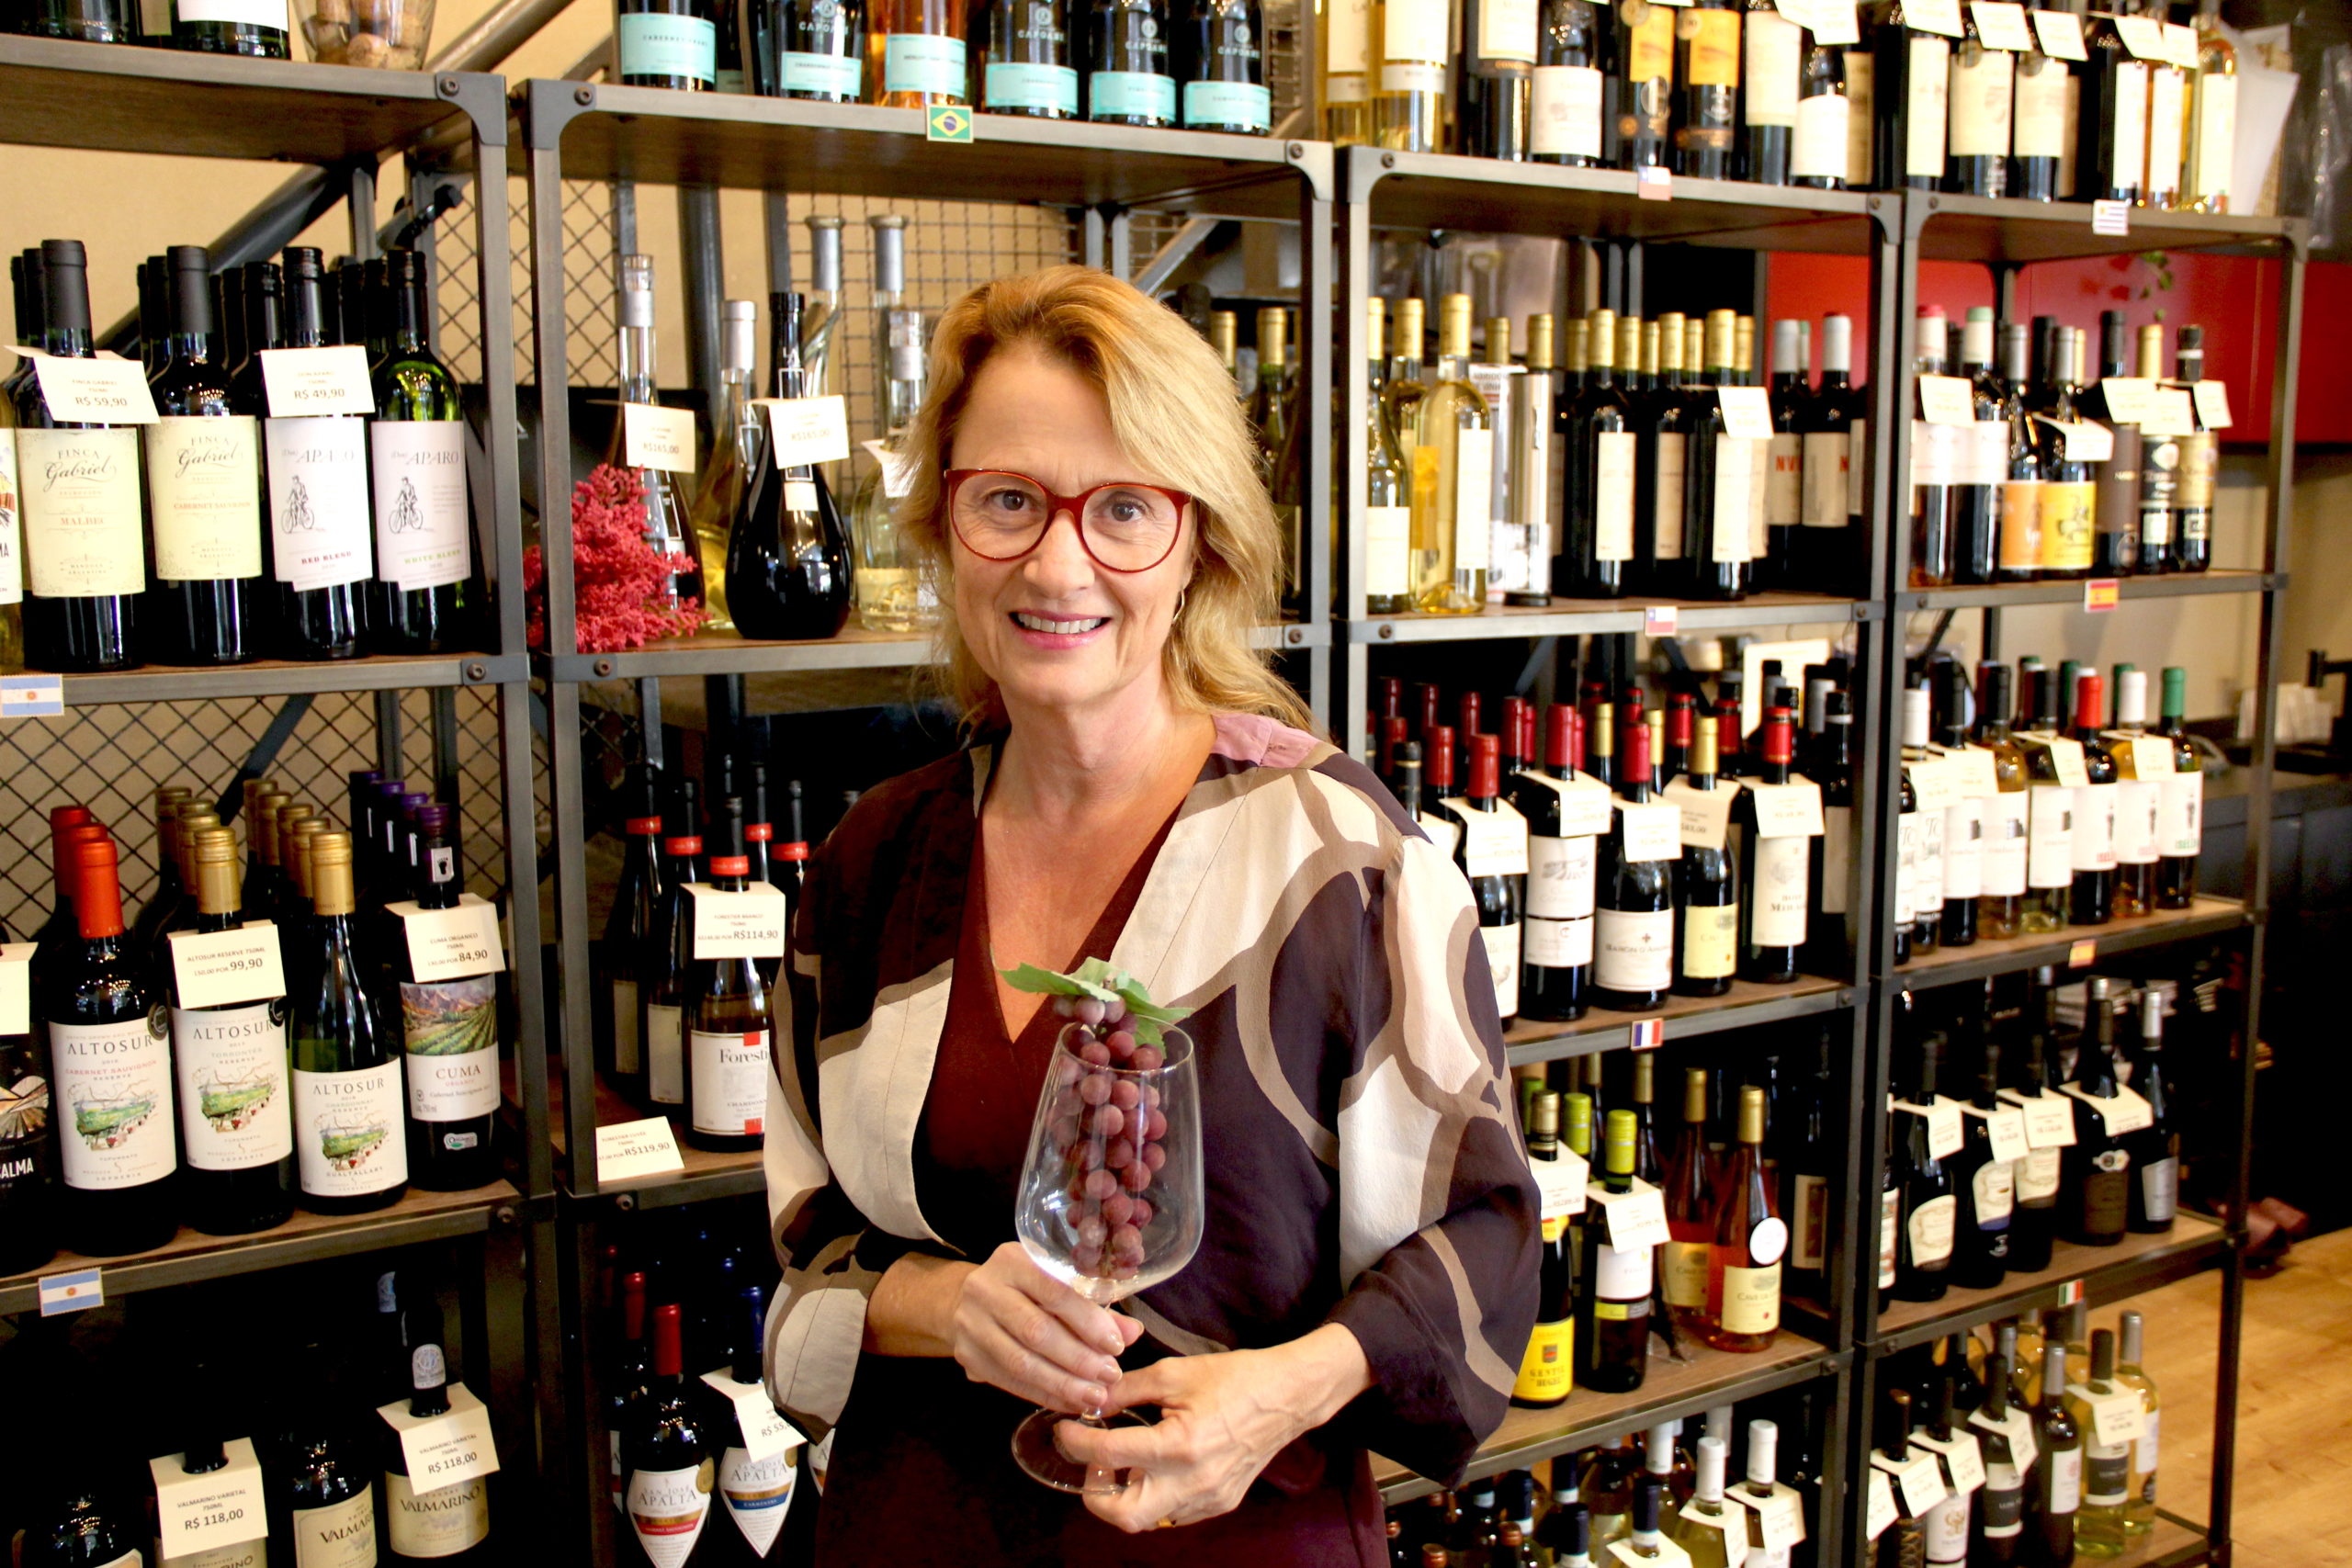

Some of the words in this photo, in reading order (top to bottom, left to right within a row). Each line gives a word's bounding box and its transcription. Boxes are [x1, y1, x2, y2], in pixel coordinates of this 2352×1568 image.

[294, 389, 309, 400] R$
[312, 388, 345, 400] 49,90
[75, 396, 91, 407] R$
[95, 397, 128, 408] 59,90
[191, 436, 229, 446] FINCA
[58, 448, 99, 459] FINCA
[175, 442, 243, 479] Gabriel
[405, 451, 459, 465] APARO
[43, 456, 117, 492] Gabriel
[61, 516, 104, 525] MALBEC
[301, 557, 320, 565] RED
[322, 551, 352, 561] BLEND
[733, 930, 779, 941] R$114,90
[187, 953, 216, 963] ALTOSUR
[218, 949, 243, 958] RESERVE
[459, 949, 488, 963] 84,90
[230, 957, 264, 971] 99,90
[193, 1019, 274, 1041] ALTOSUR
[67, 1034, 154, 1055] ALTOSUR
[65, 1066, 107, 1076] CABERNET
[110, 1059, 157, 1075] SAUVIGNON
[435, 1064, 481, 1079] CUMA
[312, 1077, 385, 1095] ALTOSUR
[625, 1142, 671, 1156] R$119,90
[761, 1427, 773, 1438] R$
[427, 1461, 441, 1474] R$
[444, 1450, 478, 1471] 118,00
[730, 1462, 788, 1482] APALTA
[177, 1495, 216, 1508] VALMARINO
[217, 1488, 246, 1499] VARIETAL
[401, 1485, 481, 1513] VALMARINO
[639, 1489, 697, 1506] APALTA
[184, 1517, 200, 1531] R$
[204, 1508, 243, 1527] 118,00
